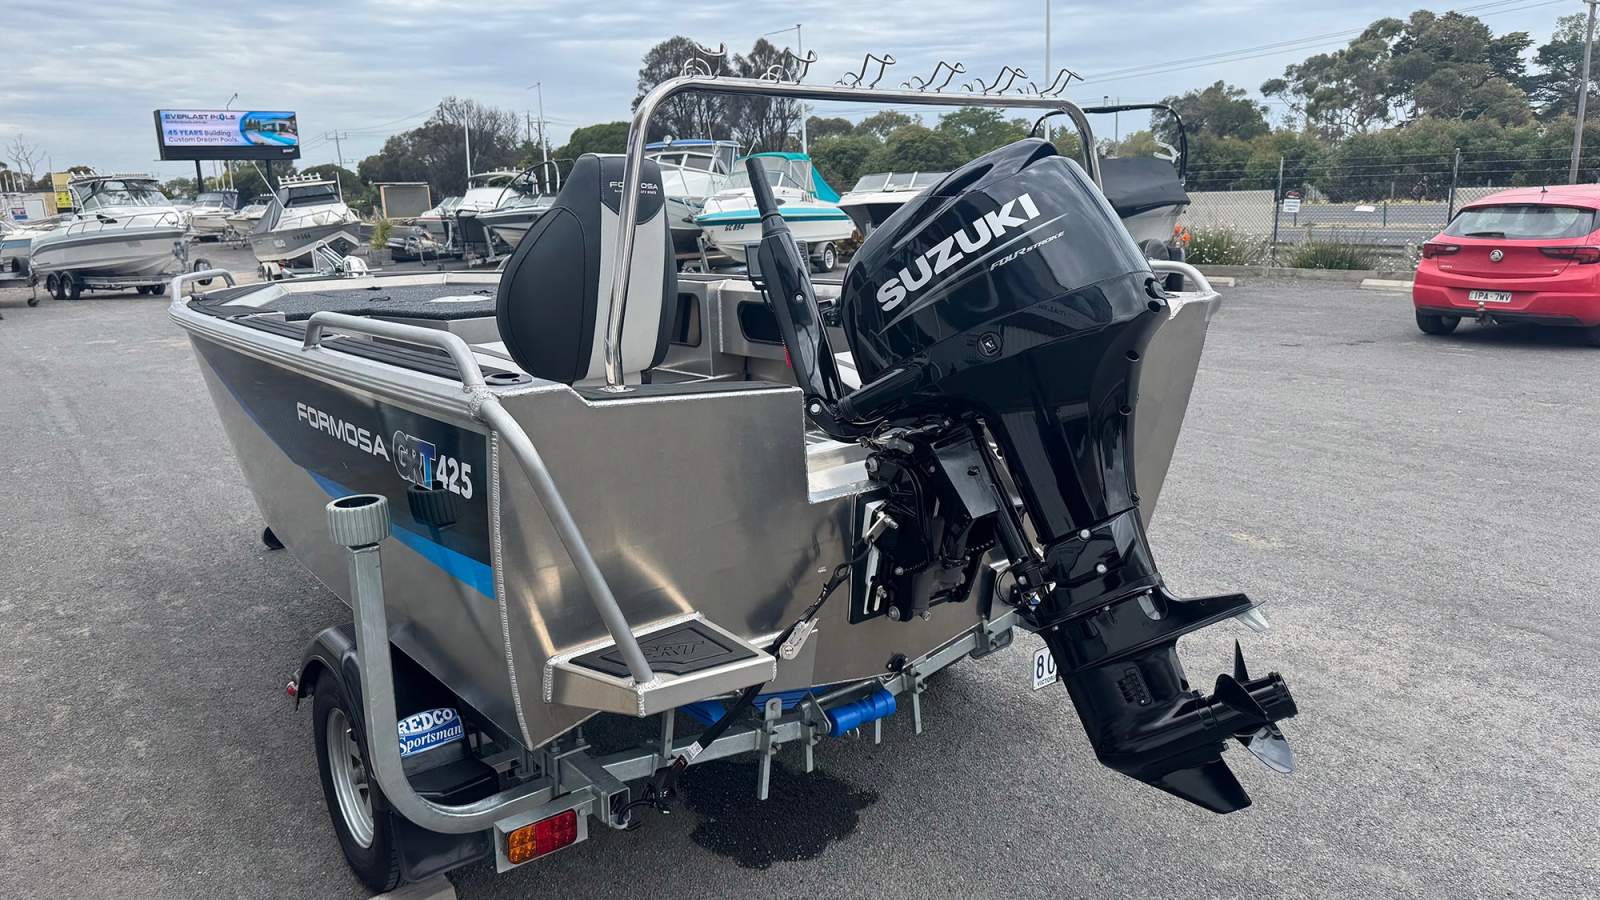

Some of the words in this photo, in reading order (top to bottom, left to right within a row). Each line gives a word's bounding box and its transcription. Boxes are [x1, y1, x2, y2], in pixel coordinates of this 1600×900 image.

[204, 129, 231, 137] Building
[609, 181, 658, 190] FOOSA
[877, 193, 1040, 311] SUZUKI
[297, 401, 390, 462] FORMOSA
[436, 454, 473, 499] 425
[398, 708, 453, 734] REDCO
[400, 725, 462, 754] Sportsman
